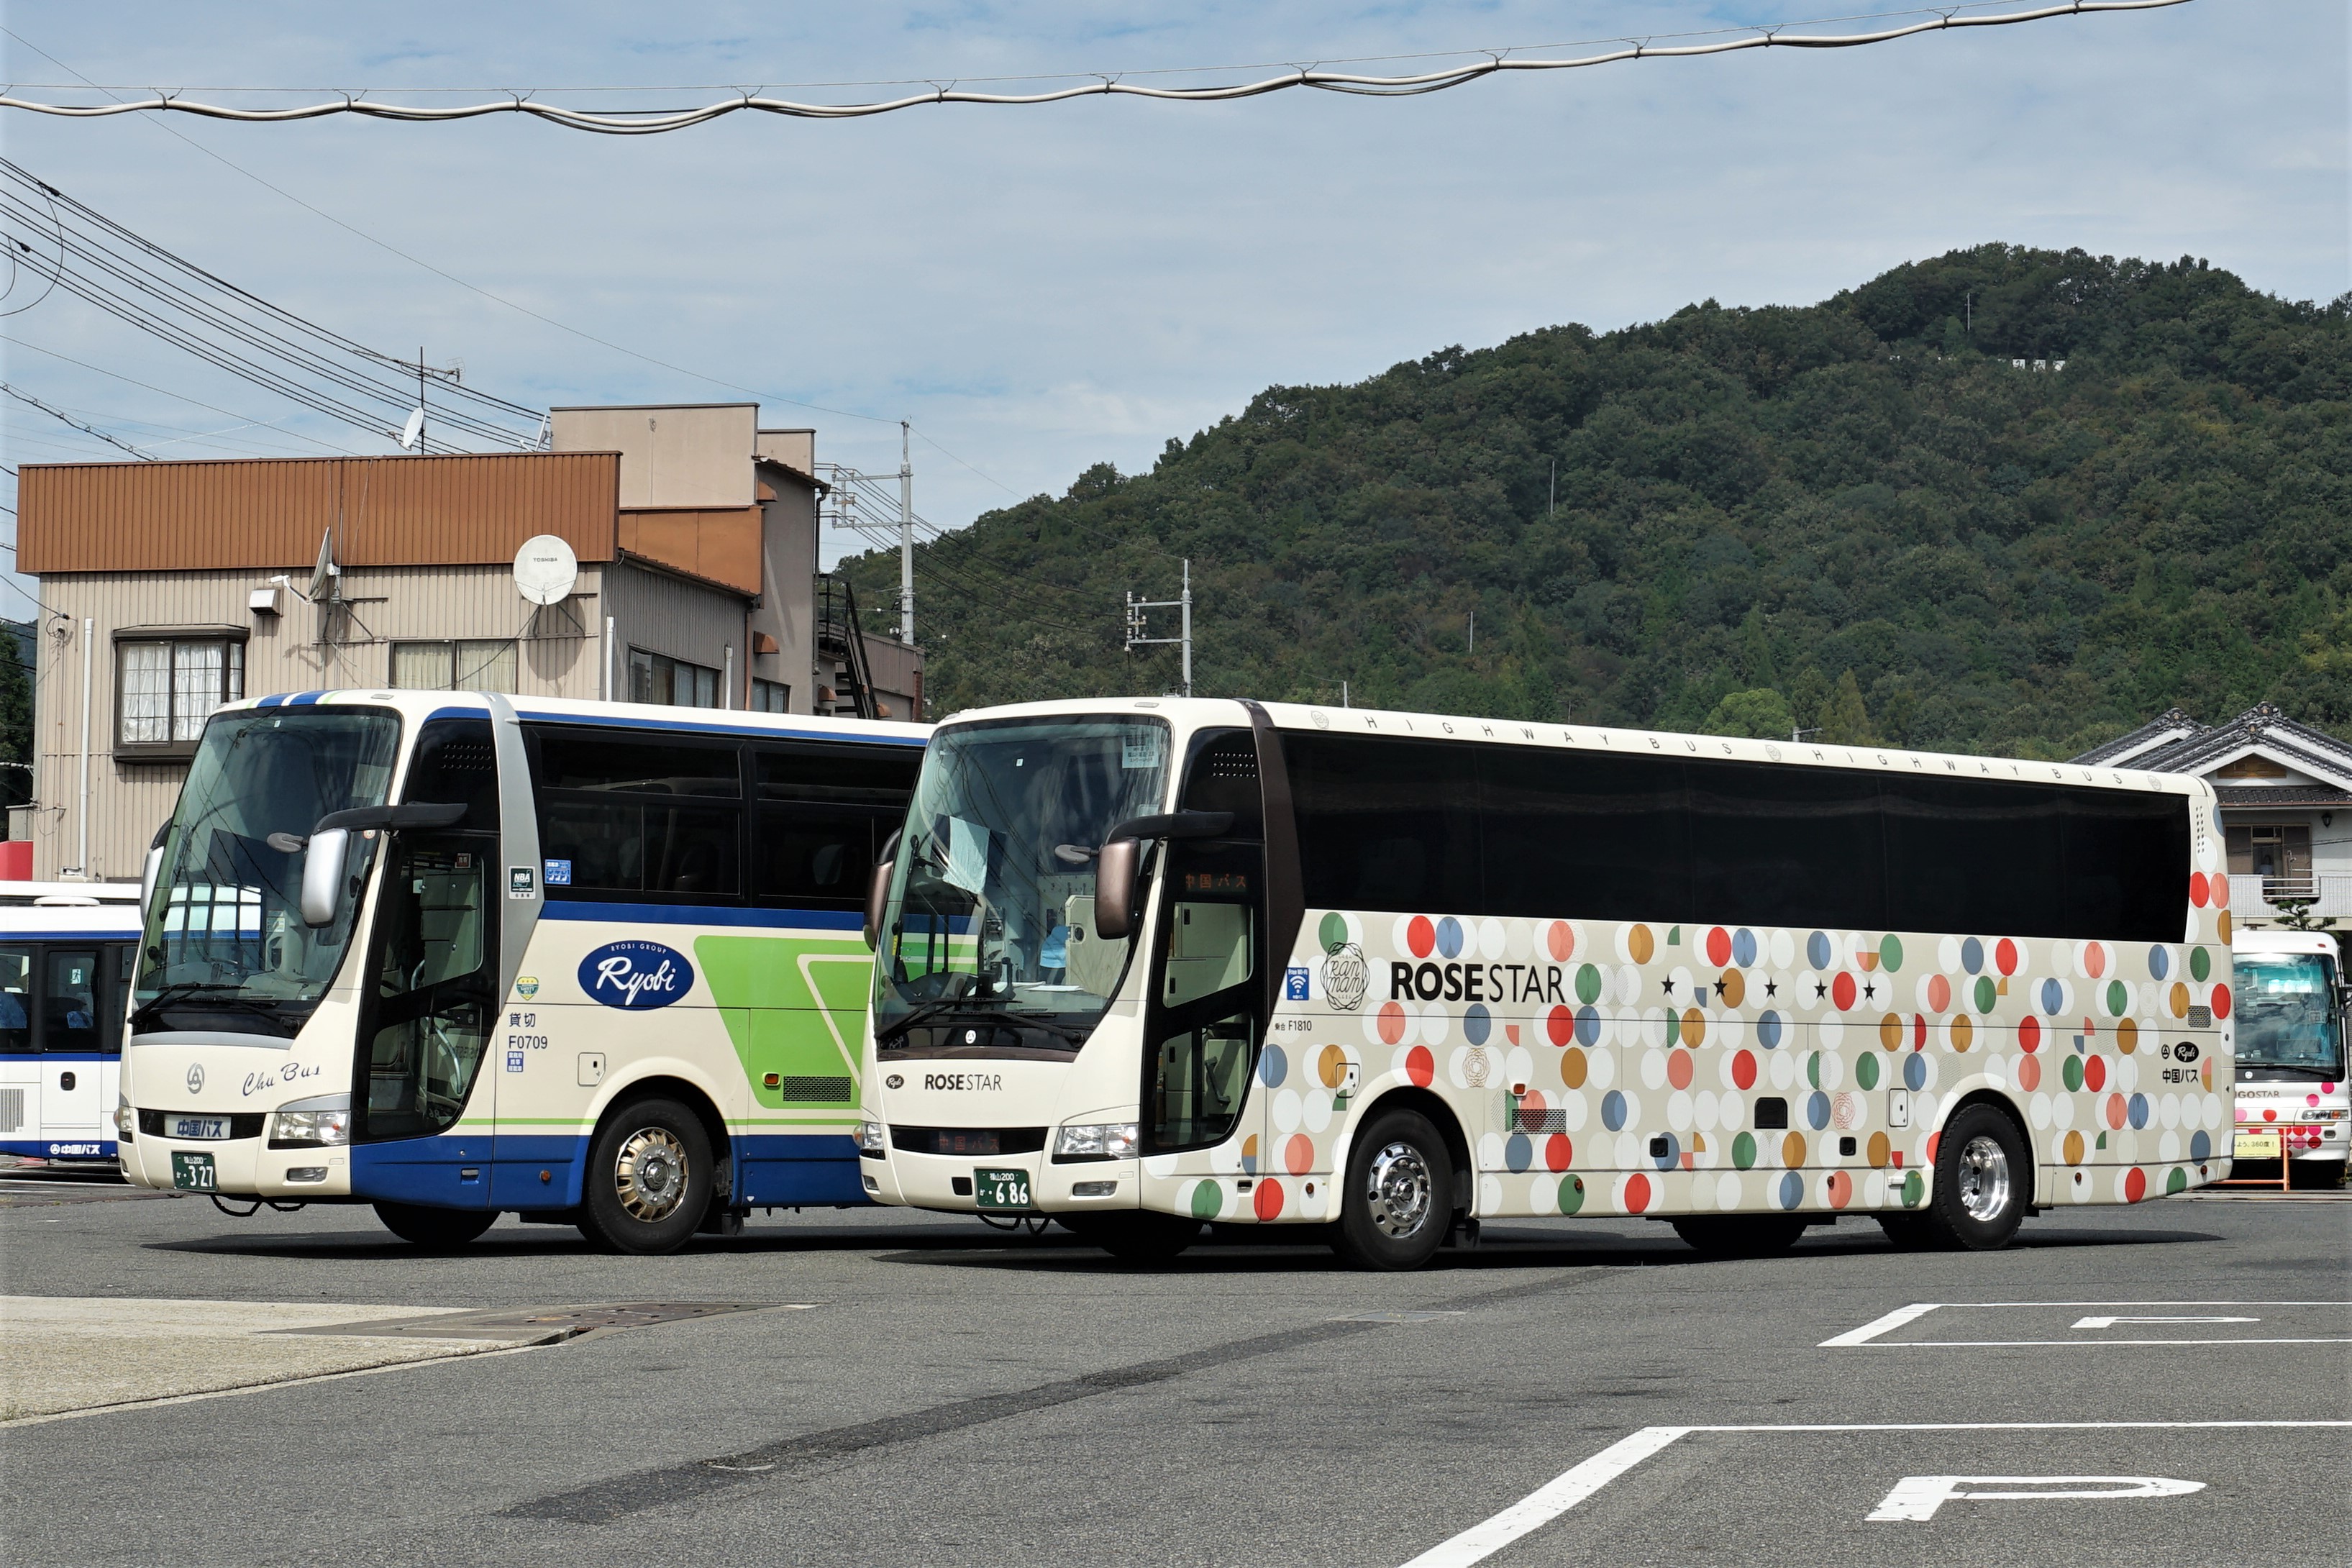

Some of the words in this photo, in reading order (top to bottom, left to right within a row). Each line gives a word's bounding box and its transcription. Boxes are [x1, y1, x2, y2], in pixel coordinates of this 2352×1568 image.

[1364, 716, 1608, 745] HIGHWAY
[1649, 737, 1732, 755] BUS
[1812, 749, 2018, 775] HIGHWAY
[2053, 768, 2122, 785] BUS
[514, 872, 531, 883] NBA
[1185, 873, 1246, 889] 中国バス
[611, 943, 635, 952] RYOBI
[640, 944, 667, 954] GROUP
[596, 957, 676, 1006] Ryobi
[509, 1012, 536, 1027] 貸切
[1288, 1020, 1312, 1031] F1810
[509, 1036, 547, 1049] F0709
[242, 1072, 275, 1096] Chu
[281, 1062, 322, 1081] Bus
[2162, 1068, 2198, 1084] 中国バス
[177, 1119, 223, 1137] 中国バス
[61, 1144, 100, 1154] 中国バス
[939, 1136, 999, 1150] 中国バス
[1864, 1476, 2207, 1521] P
